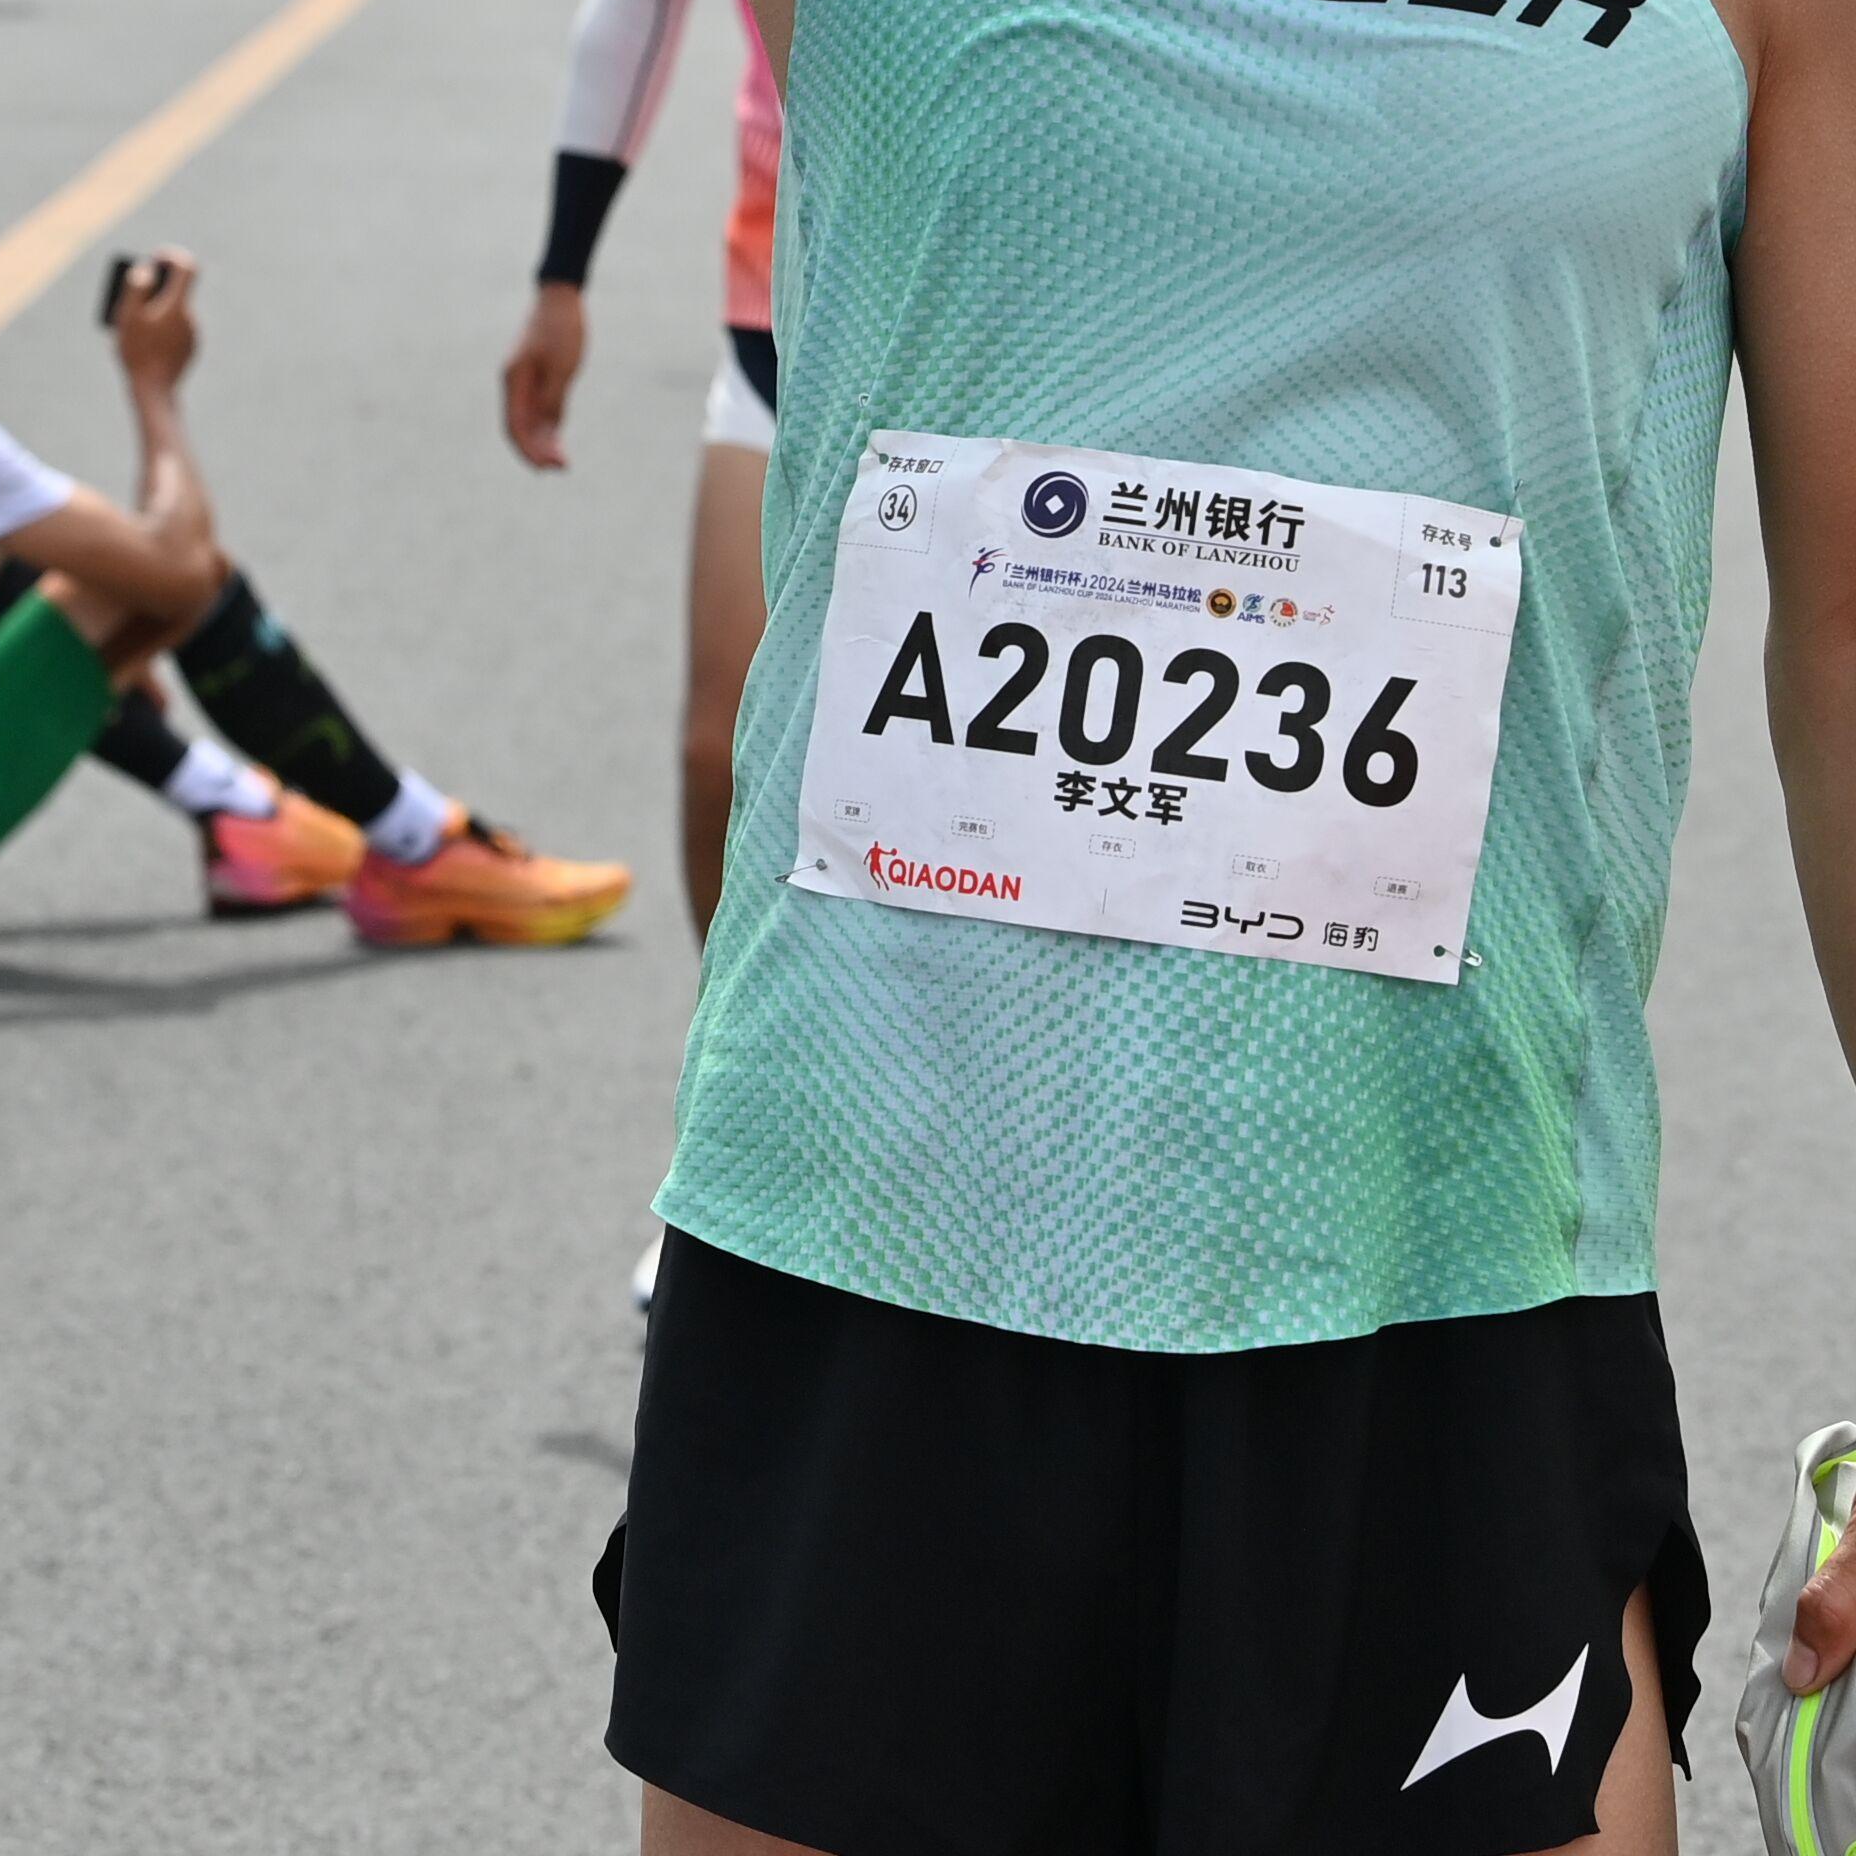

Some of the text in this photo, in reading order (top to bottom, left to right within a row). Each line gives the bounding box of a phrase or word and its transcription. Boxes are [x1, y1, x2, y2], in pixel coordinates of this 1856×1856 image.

[887, 456, 944, 474] 存衣窗口
[884, 493, 910, 523] 34
[1102, 482, 1305, 549] 兰州银行
[1097, 531, 1300, 573] BANK OF LANZHOU
[1421, 524, 1472, 551] 存衣号
[1002, 579, 1201, 614] BANK OF LANZHOU CUP 2024 LANZHOU MARATHON
[1004, 562, 1201, 604] 「兰州银行杯」2024兰州马拉松
[1422, 563, 1467, 599] 113
[1237, 611, 1265, 624] AIMS
[862, 610, 1419, 809] A20236
[1054, 770, 1187, 826] 李文军
[958, 821, 988, 835] 完赛包
[1101, 841, 1123, 853] 存衣
[888, 858, 1022, 901] QIAODAN
[1245, 861, 1267, 874] 取衣
[1180, 900, 1379, 952] BYD 海豹
